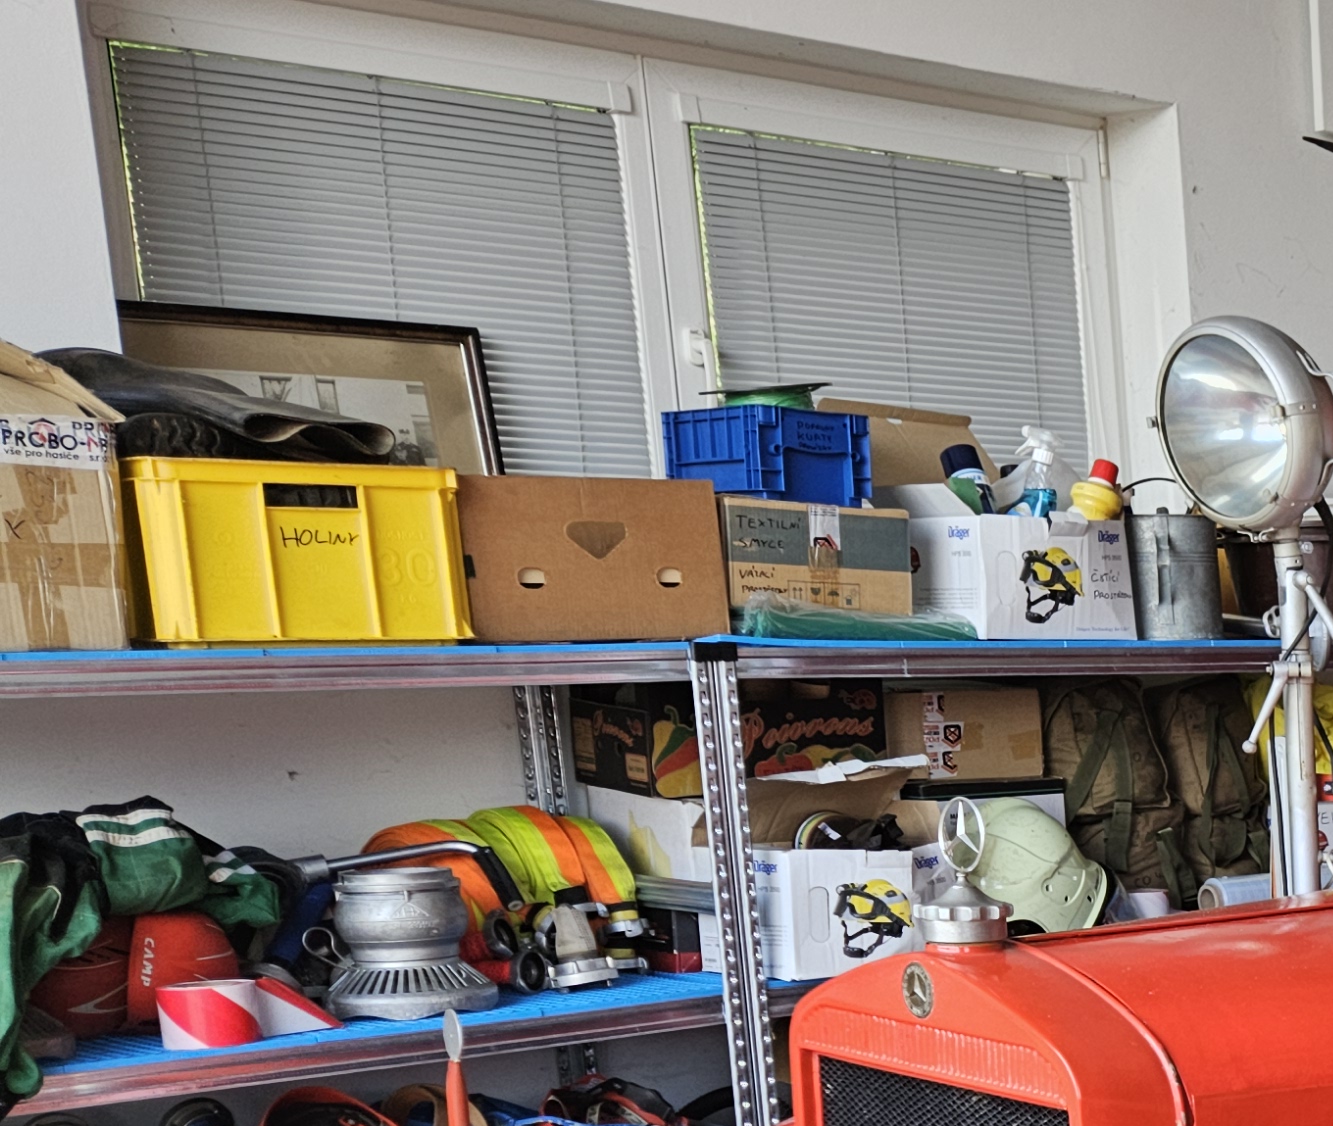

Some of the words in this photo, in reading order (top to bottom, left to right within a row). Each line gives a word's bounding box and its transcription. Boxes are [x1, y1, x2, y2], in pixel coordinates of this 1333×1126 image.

[4, 447, 22, 456] vše
[25, 450, 43, 458] pro
[45, 451, 79, 460] hasiče
[736, 515, 802, 530] TEXTILNÍ
[280, 526, 360, 548] HOLINY
[947, 525, 970, 540] Dräger
[1097, 530, 1120, 545] Dräger
[736, 706, 874, 762] Poivrons
[752, 859, 778, 875] Dräger
[914, 855, 939, 870] Dräger
[141, 937, 155, 987] CAMP
